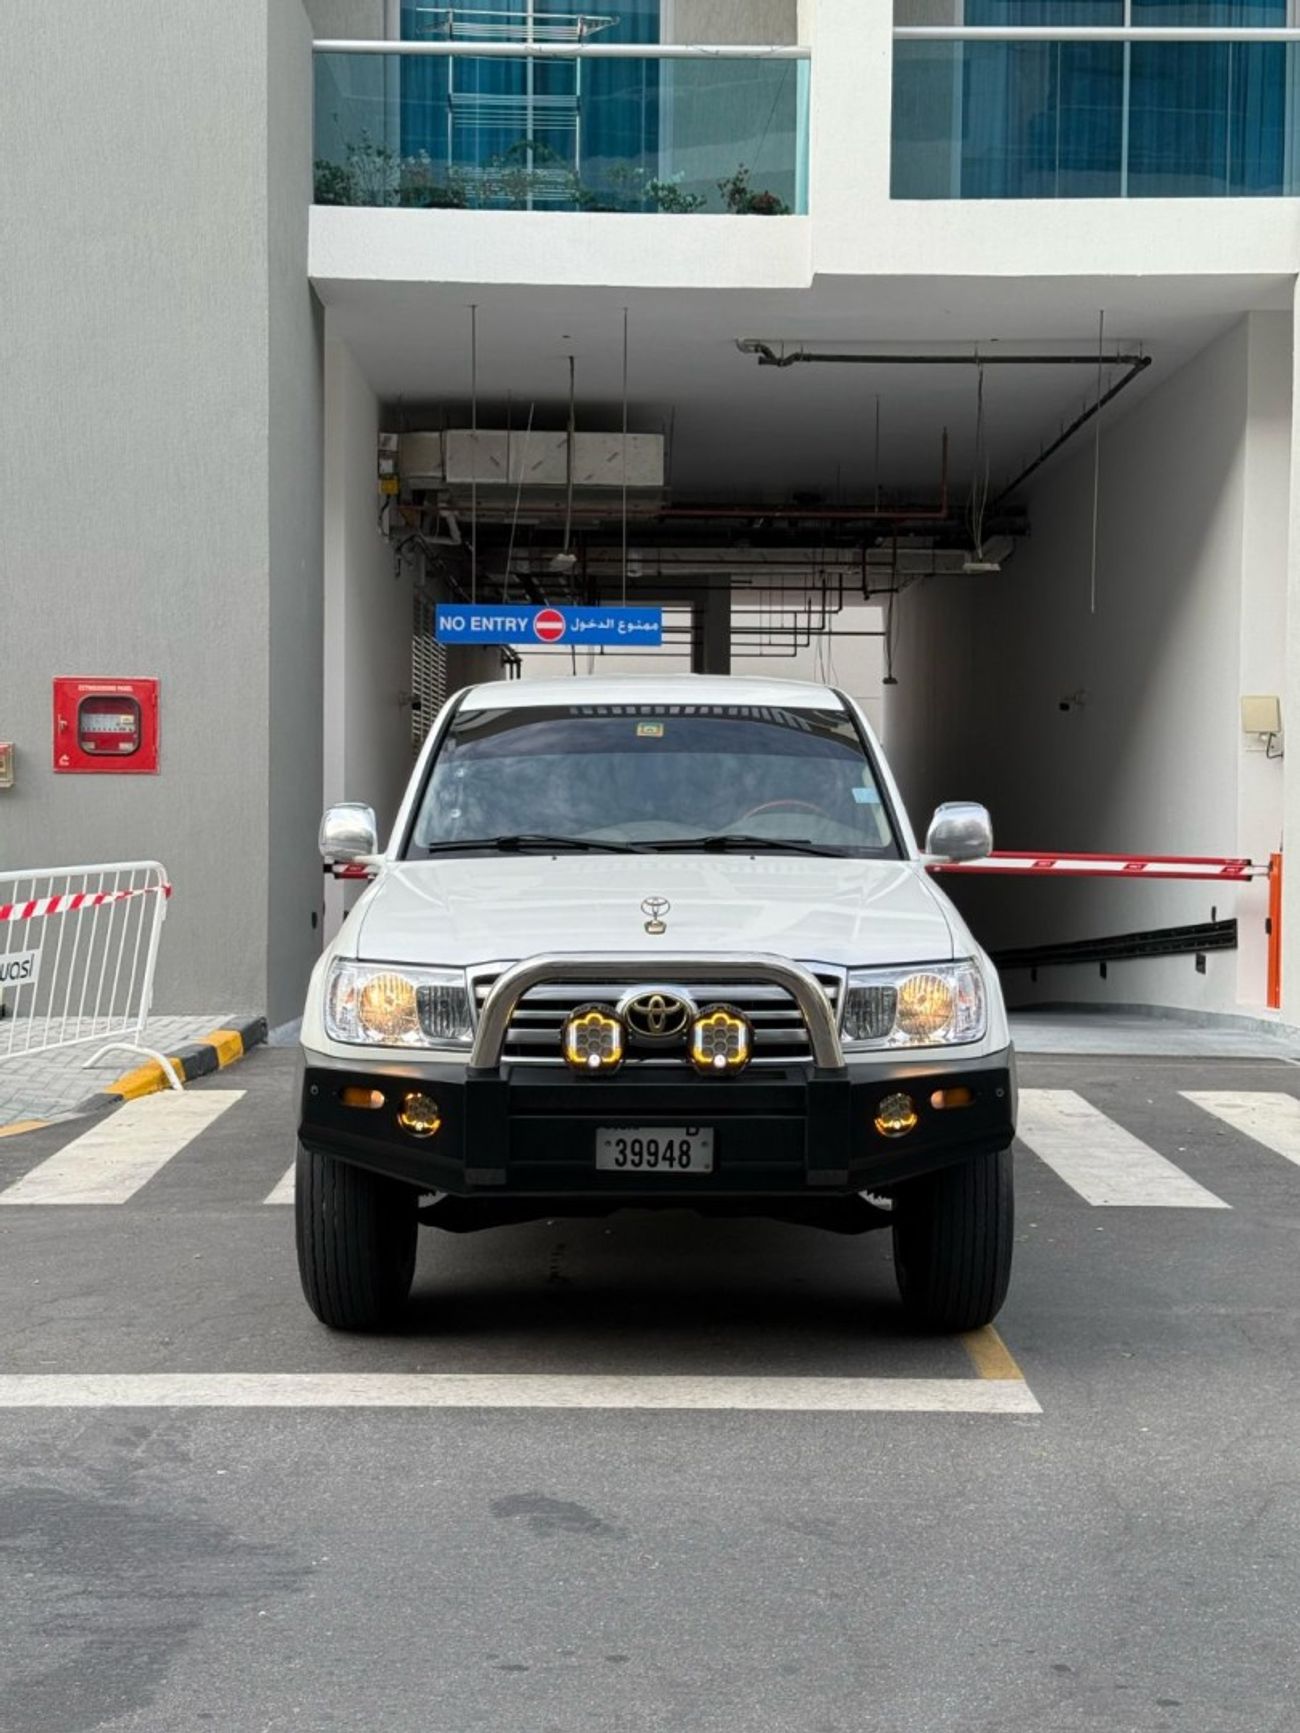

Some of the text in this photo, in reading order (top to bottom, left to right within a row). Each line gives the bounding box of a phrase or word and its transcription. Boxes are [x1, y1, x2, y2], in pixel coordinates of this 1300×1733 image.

[440, 616, 528, 632] NO ENTRY
[570, 617, 659, 634] ممنوع الدخول
[615, 1138, 691, 1169] 39948
